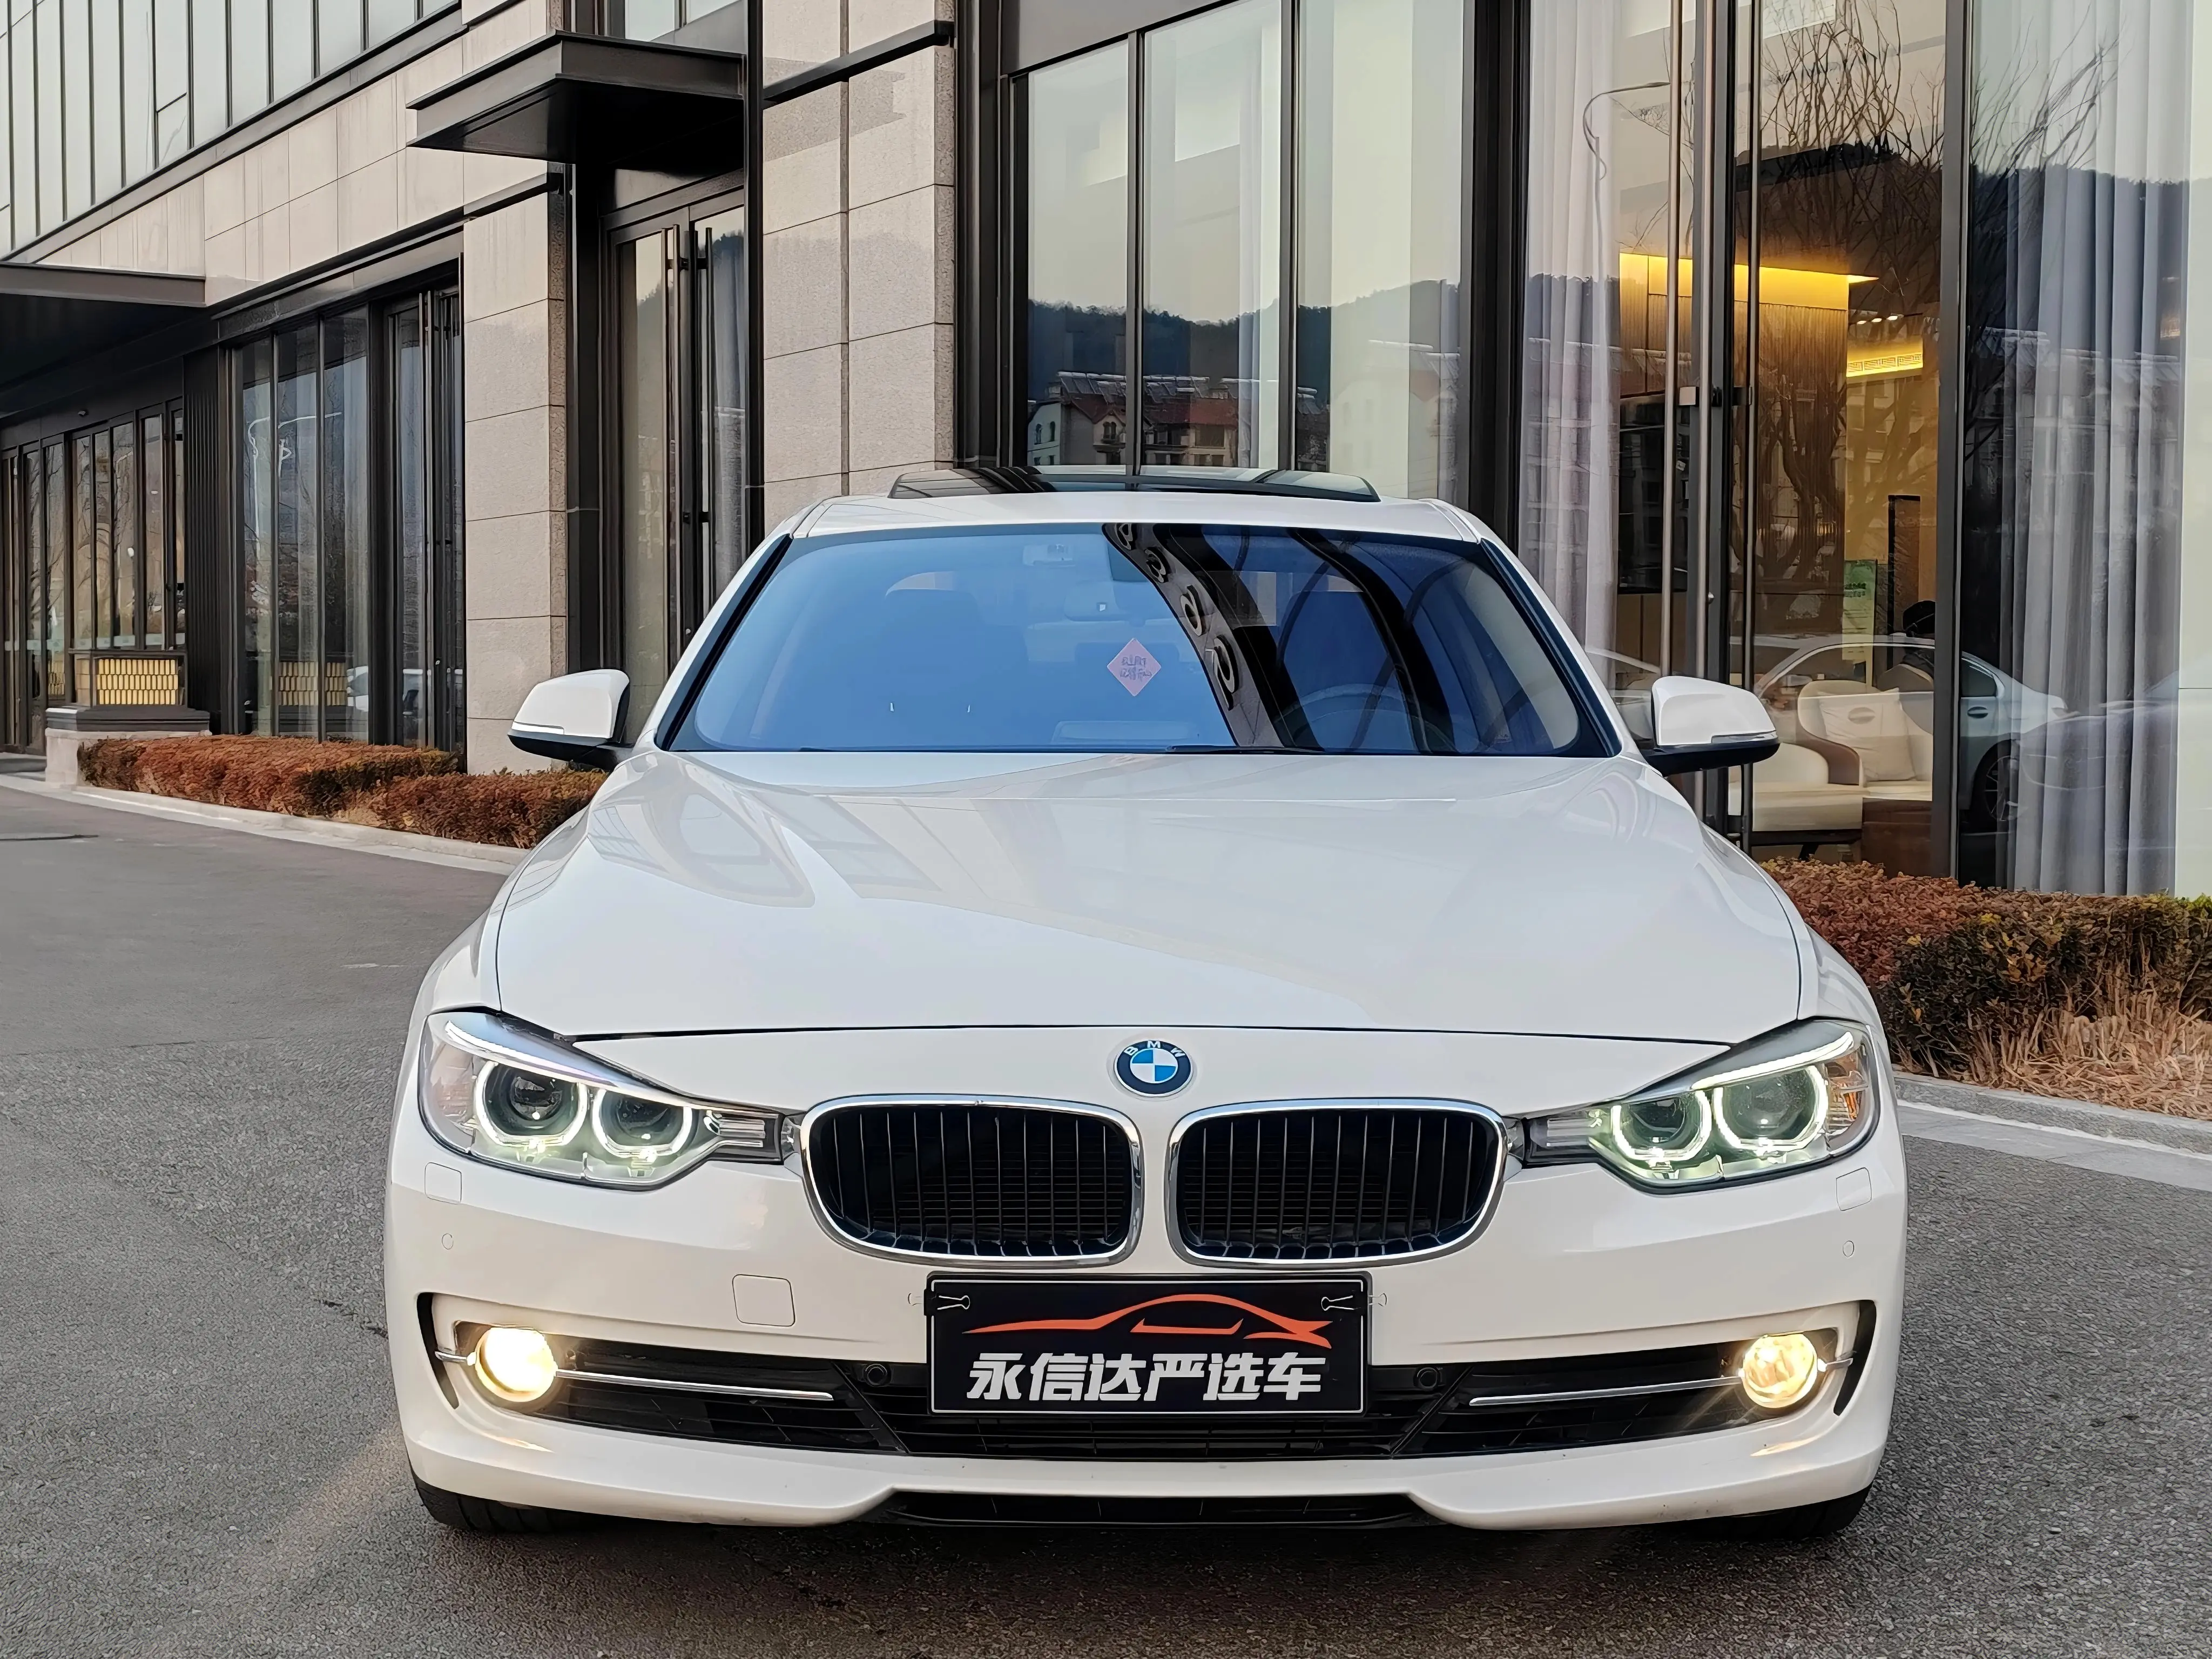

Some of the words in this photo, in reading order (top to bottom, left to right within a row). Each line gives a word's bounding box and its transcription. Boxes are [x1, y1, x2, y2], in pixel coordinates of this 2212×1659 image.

[1124, 1040, 1185, 1057] BMW
[967, 1352, 1326, 1401] 永信达严选车
